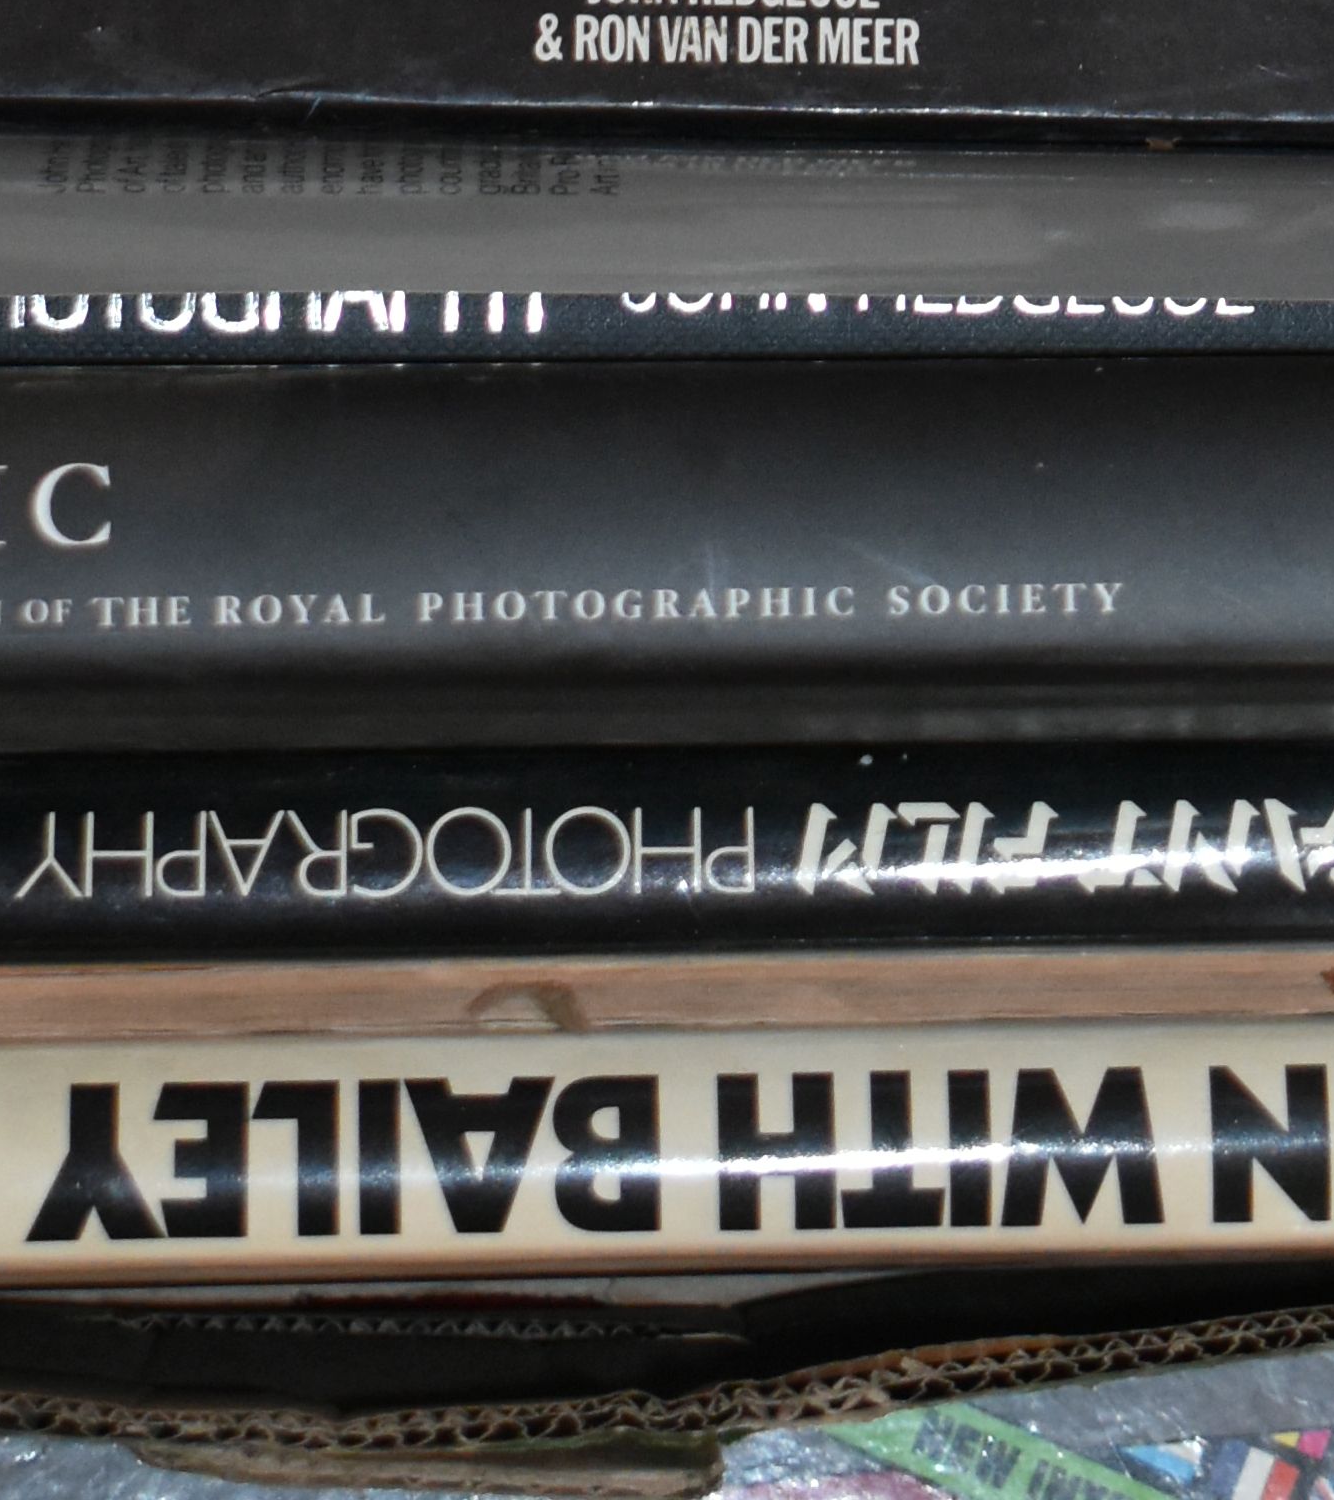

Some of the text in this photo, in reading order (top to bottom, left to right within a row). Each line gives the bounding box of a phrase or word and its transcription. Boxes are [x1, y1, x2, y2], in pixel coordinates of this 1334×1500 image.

[534, 13, 921, 68] & RON VAN DER MEER
[23, 597, 73, 627] OF
[94, 594, 192, 628] THE
[214, 591, 387, 627] ROYAL
[416, 585, 856, 623] PHOTOGRAPHIC
[887, 581, 1127, 618] SOCIETY
[14, 805, 757, 900] PHOTOGRAPHY
[794, 799, 1060, 896] FILM
[26, 1073, 663, 1244] BAILEY
[716, 1067, 1166, 1231] WITH
